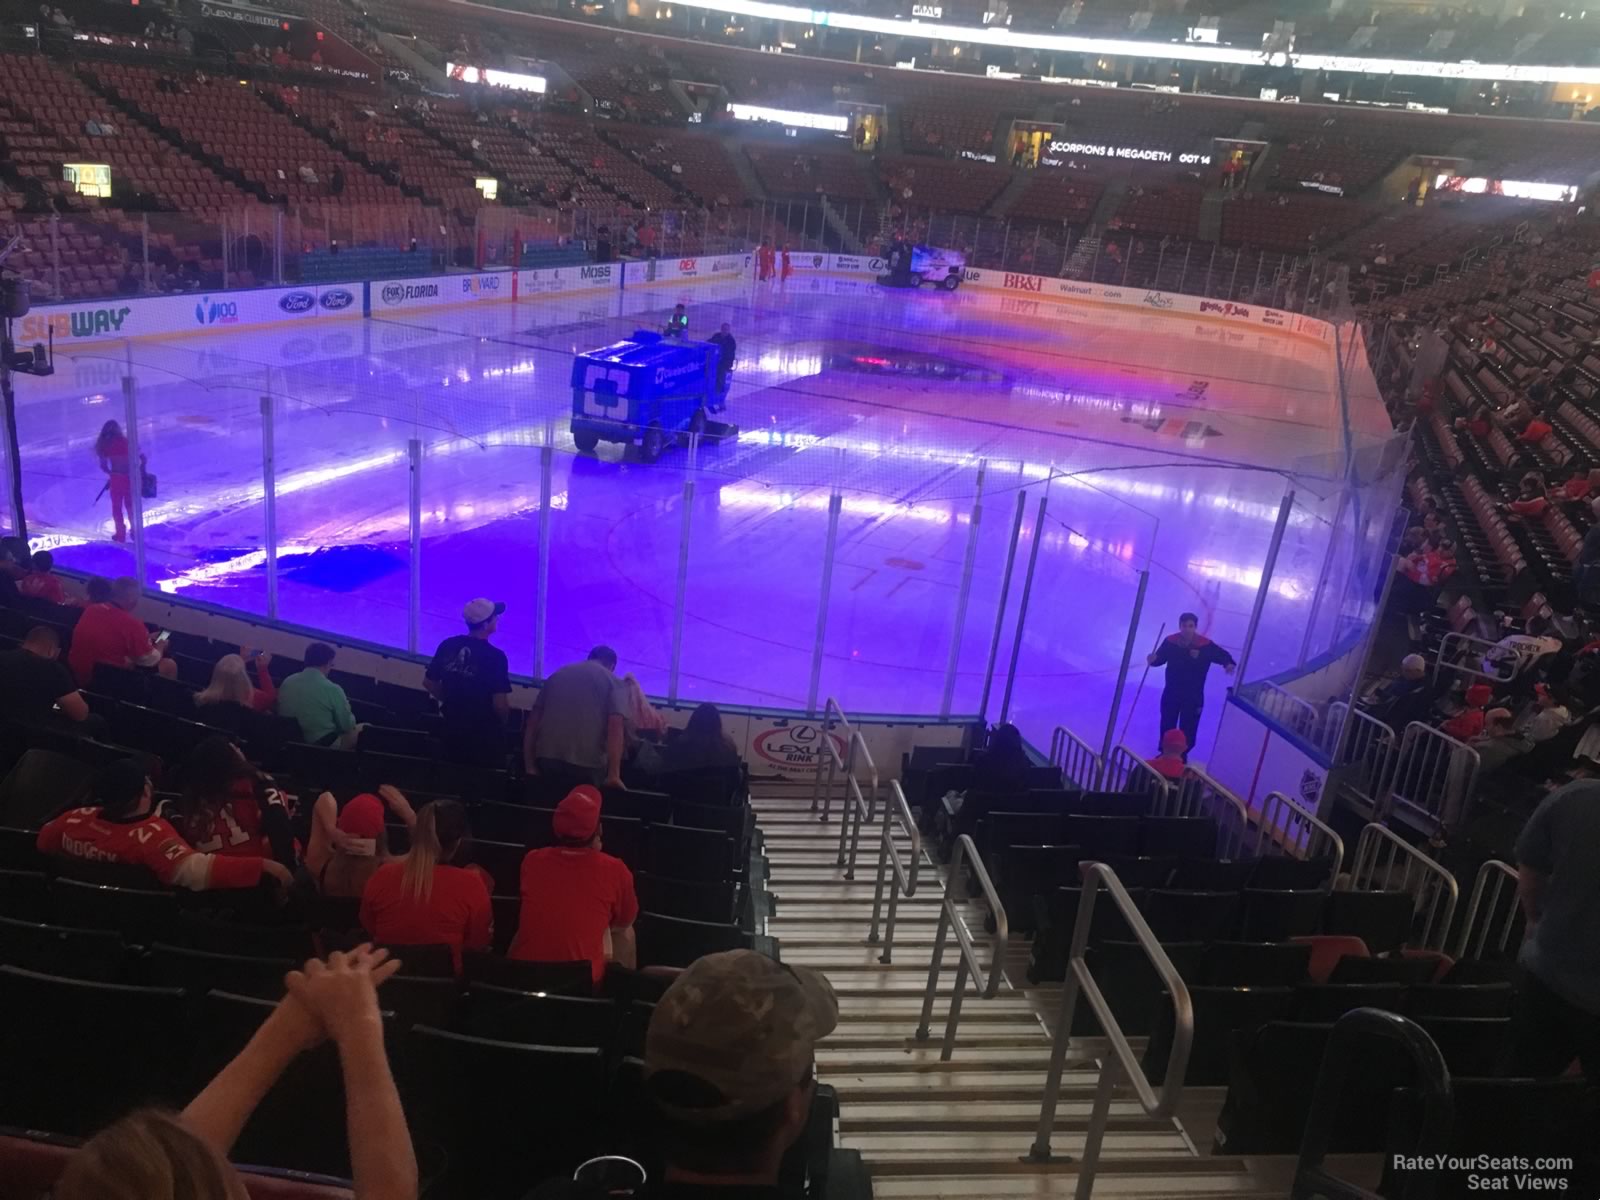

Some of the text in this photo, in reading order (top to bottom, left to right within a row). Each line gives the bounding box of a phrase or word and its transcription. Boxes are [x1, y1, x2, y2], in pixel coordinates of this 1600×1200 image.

[1050, 141, 1106, 157] SCORPIONS
[1107, 146, 1114, 157] &
[1116, 148, 1172, 162] MEGADETH
[1200, 155, 1211, 165] 14
[679, 259, 697, 271] DEX
[1003, 273, 1044, 292] BB&T
[1060, 283, 1092, 295] Walmart
[386, 284, 439, 299] FOX FLORIDA
[20, 307, 131, 342] SUBWAY
[785, 753, 814, 763] RINK
